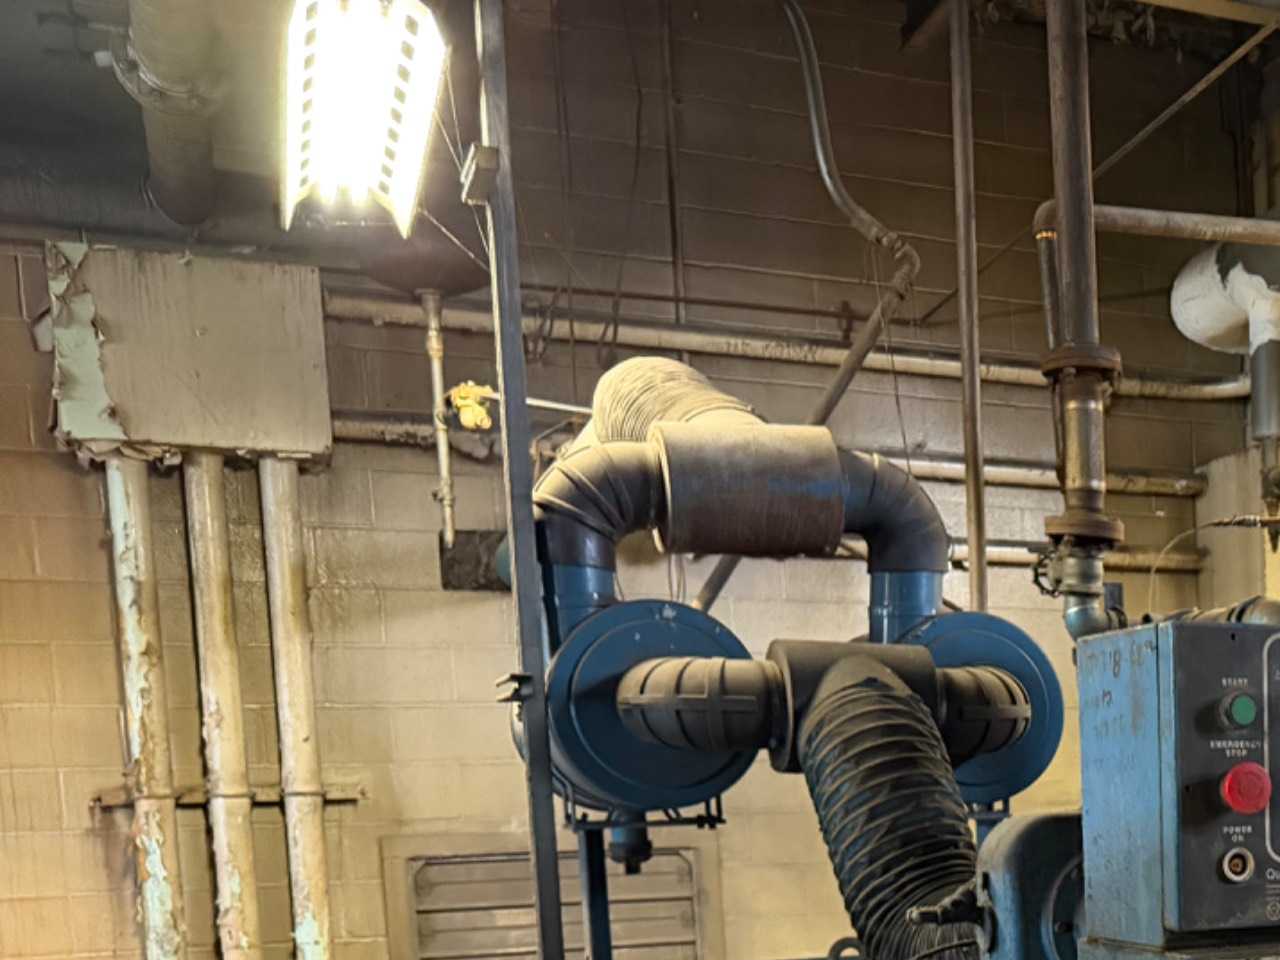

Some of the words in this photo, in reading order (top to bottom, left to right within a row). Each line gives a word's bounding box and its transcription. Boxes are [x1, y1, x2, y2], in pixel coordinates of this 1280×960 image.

[1221, 677, 1249, 687] START
[1210, 740, 1261, 749] EMERGENCY
[1225, 749, 1248, 757] STOP
[1222, 825, 1252, 833] POWER
